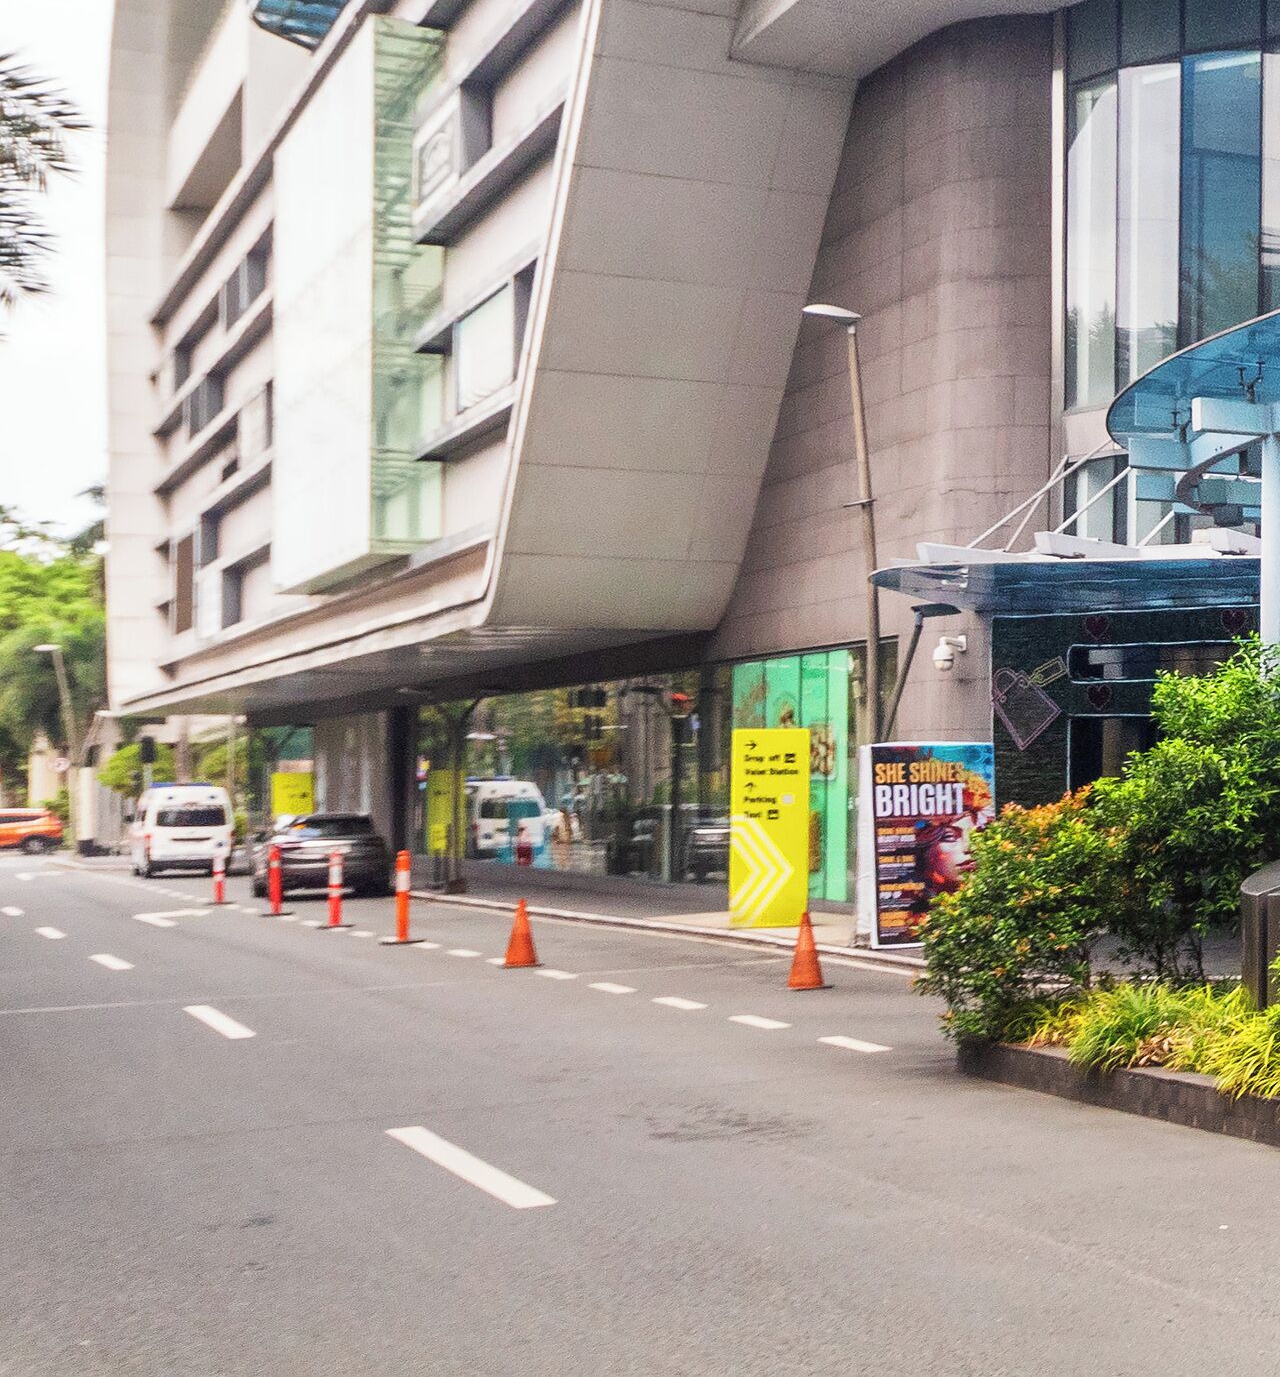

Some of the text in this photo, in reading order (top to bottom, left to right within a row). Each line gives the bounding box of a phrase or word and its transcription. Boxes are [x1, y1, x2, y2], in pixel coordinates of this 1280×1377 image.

[875, 761, 966, 784] SHE SHINES
[743, 795, 777, 804] Parking
[875, 783, 966, 817] BRIGHT
